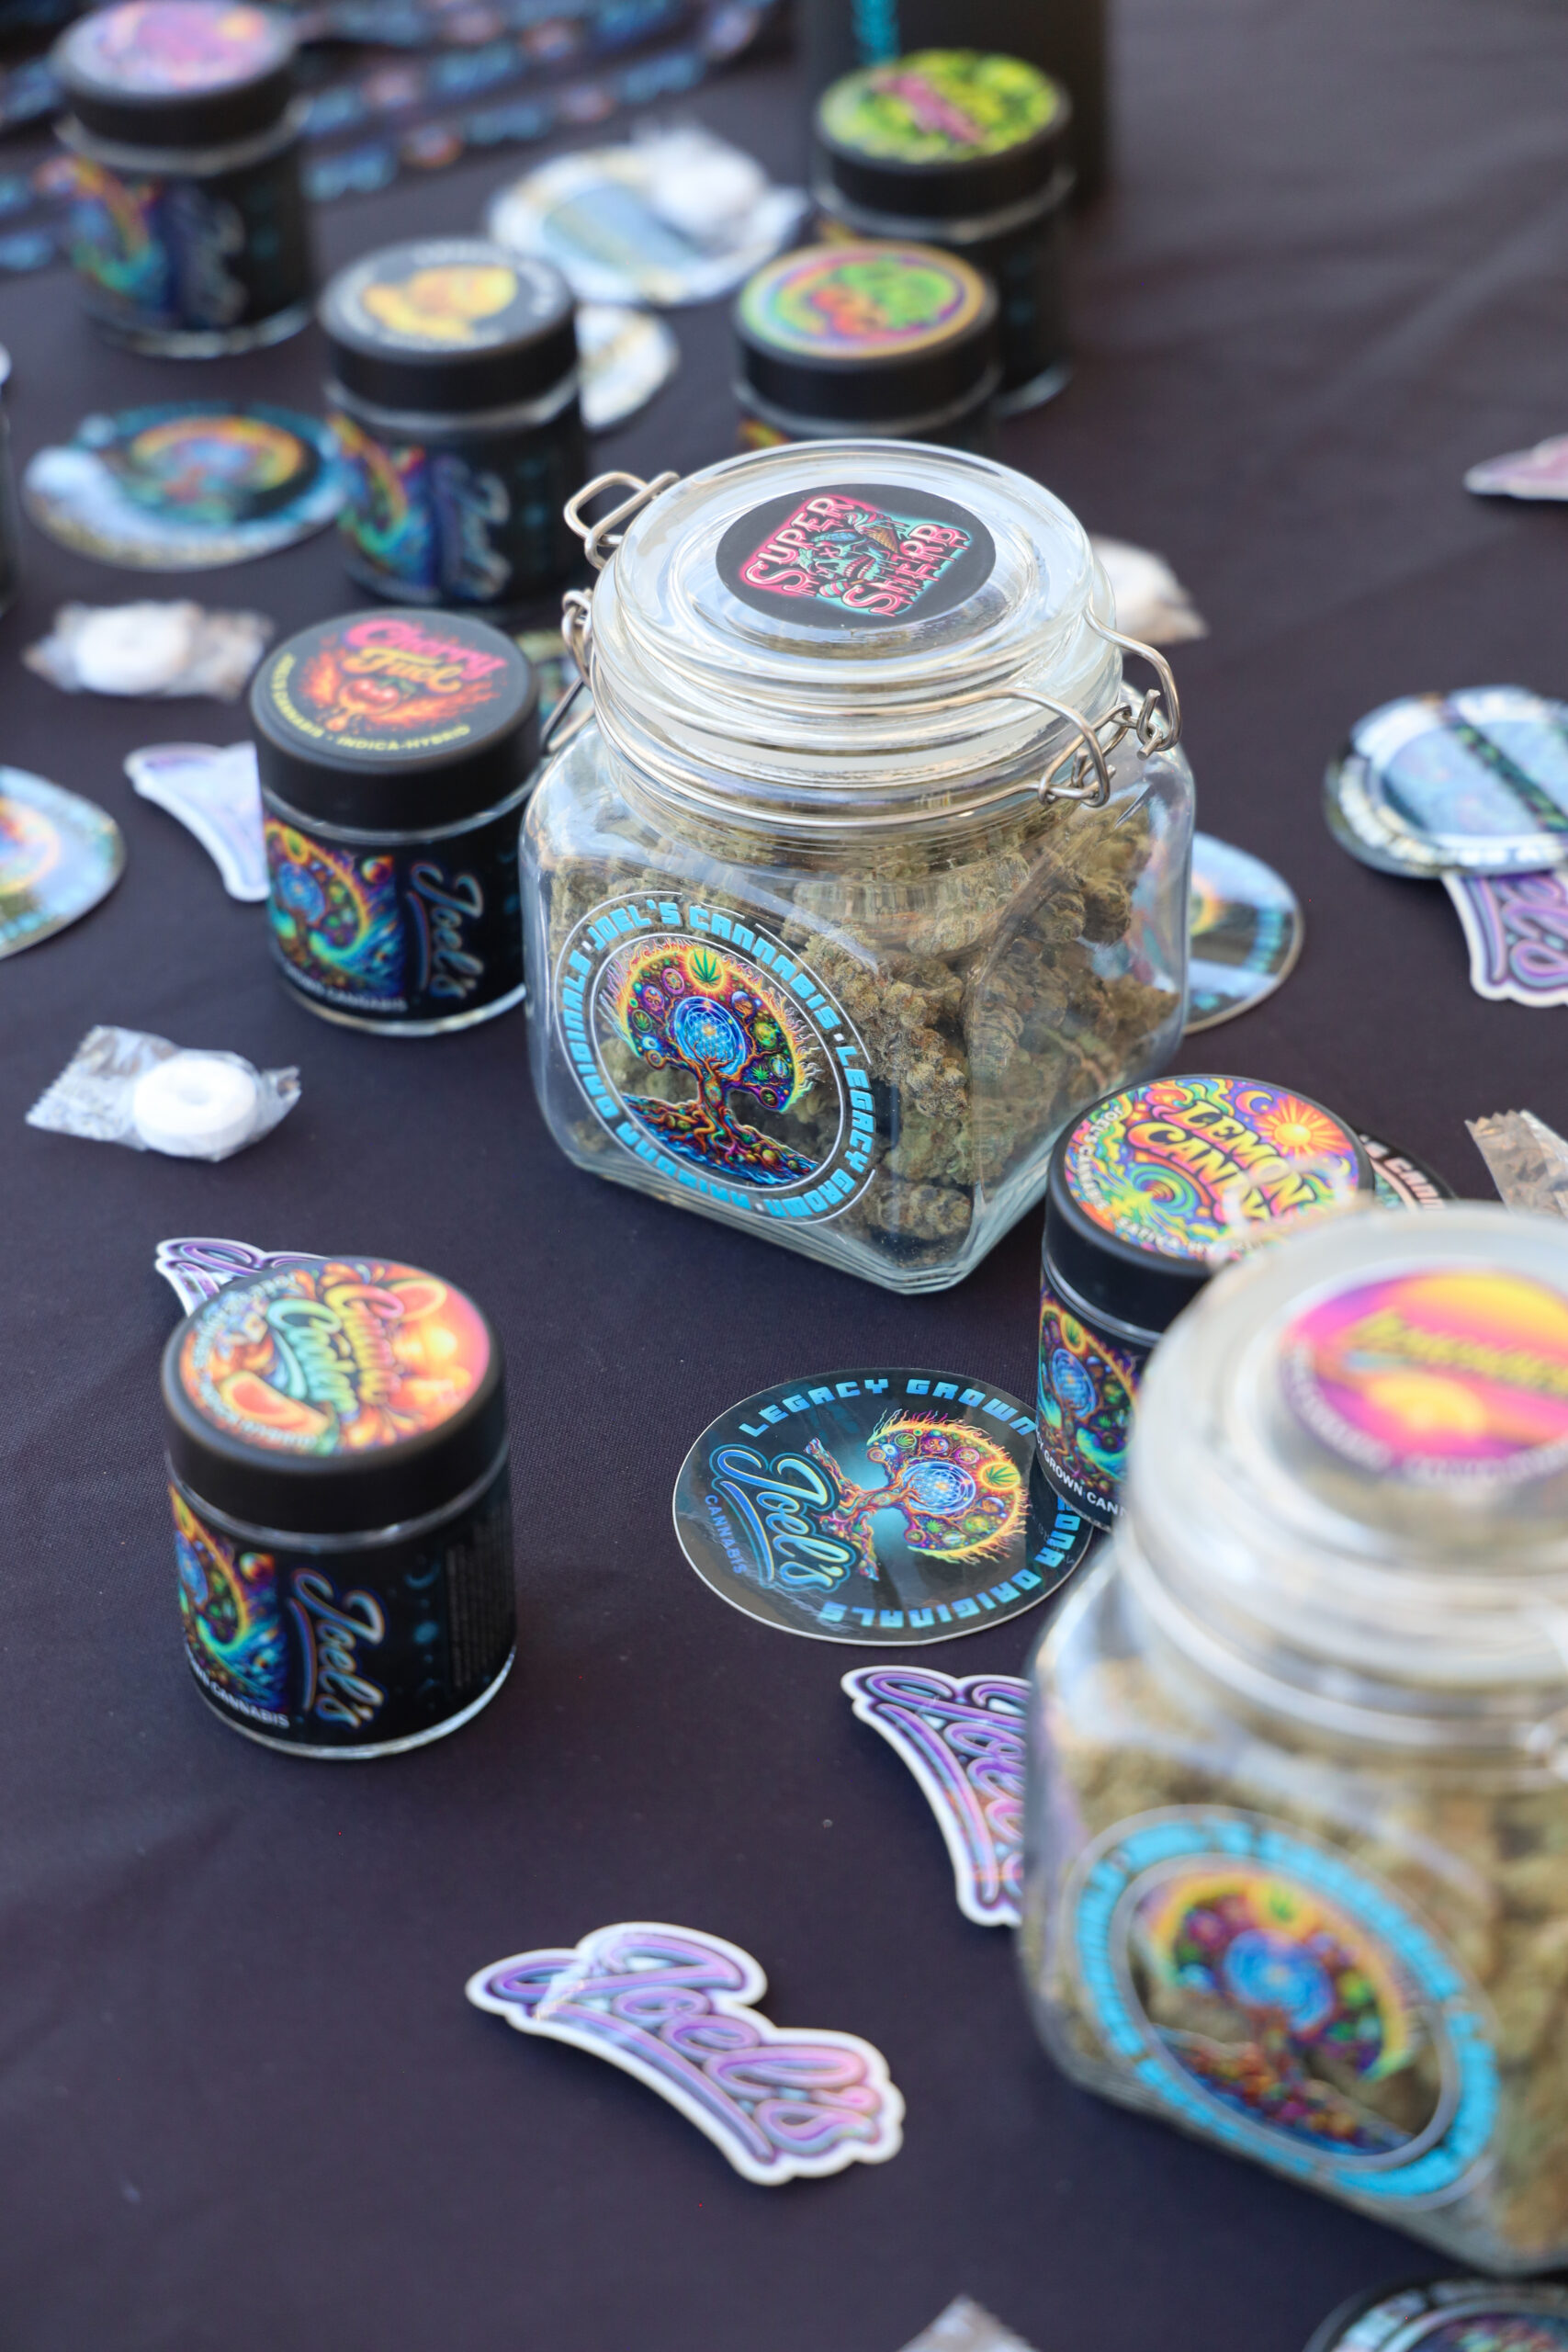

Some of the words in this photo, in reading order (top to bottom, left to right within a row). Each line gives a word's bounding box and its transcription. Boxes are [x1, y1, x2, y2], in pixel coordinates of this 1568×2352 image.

[745, 496, 855, 597] SUPER
[841, 523, 971, 617] SHERB
[587, 899, 682, 952] JOEL'S
[689, 905, 842, 1030] CANNABIS
[562, 948, 620, 1119] ORIGINALS
[835, 1045, 874, 1173] LEGACY
[1083, 1104, 1123, 1144] JOEL'S
[615, 1120, 752, 1211] ARIZONA
[762, 1168, 856, 1218] GROWN
[1162, 1101, 1316, 1216] LEMON
[739, 1378, 890, 1438] LEGACY
[906, 1377, 1037, 1437] GROWN
[1043, 1449, 1083, 1498] GROWN
[705, 1493, 749, 1575] CANNABIS
[717, 1448, 851, 1588] Joel's
[818, 1567, 1043, 1629] ORIGINALS
[210, 1680, 291, 1729] CANNABIS
[490, 1932, 884, 2165] Joel's
